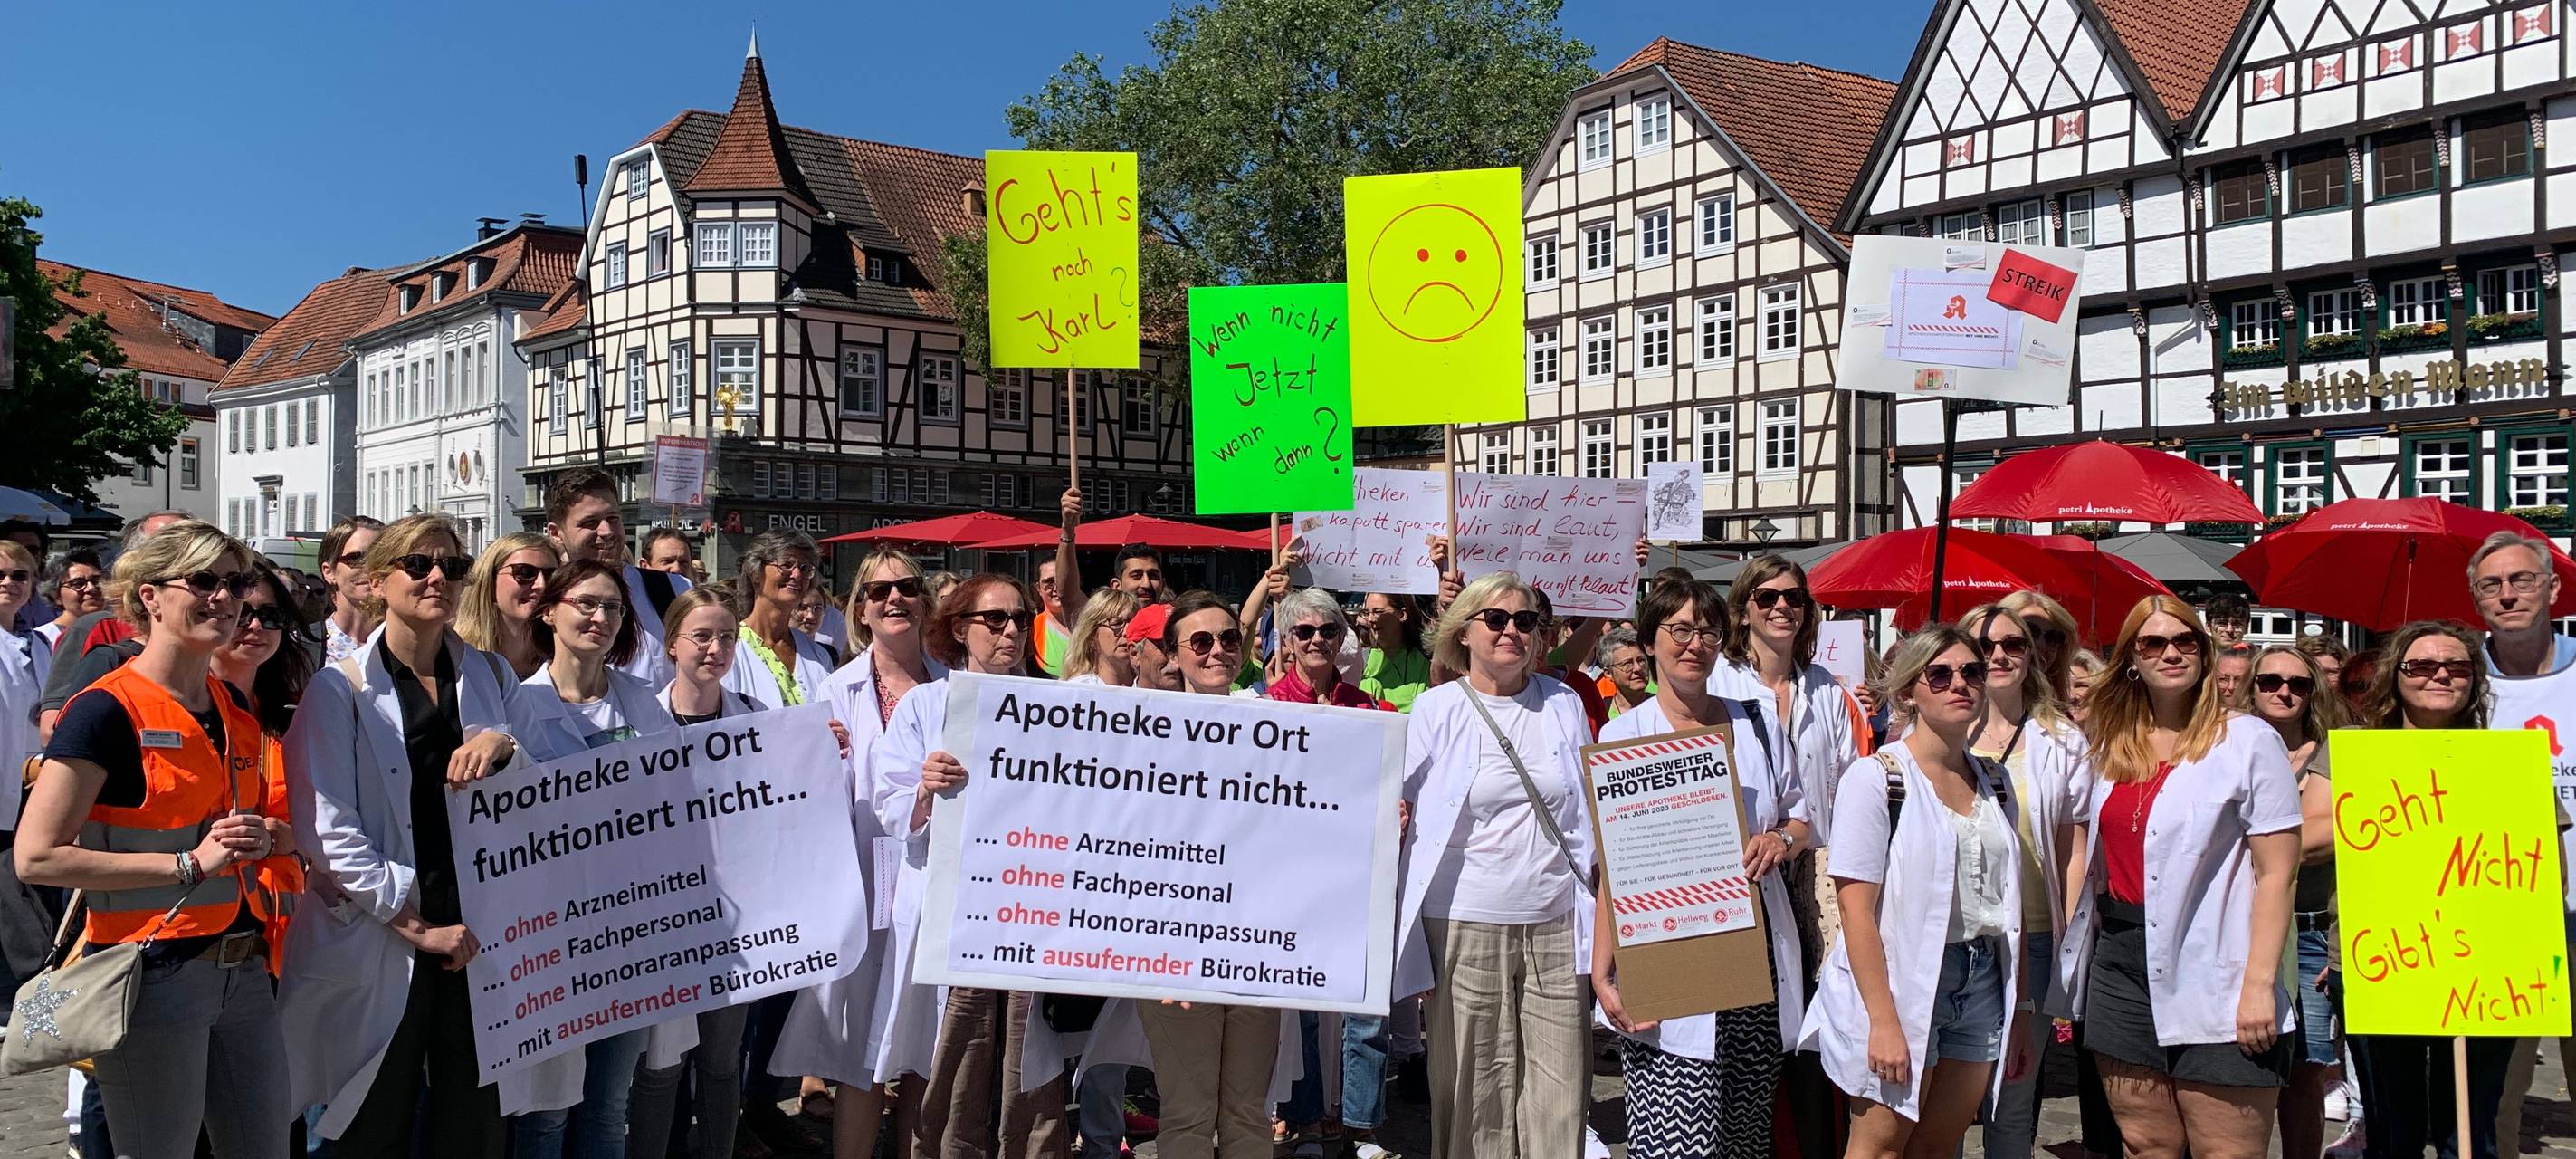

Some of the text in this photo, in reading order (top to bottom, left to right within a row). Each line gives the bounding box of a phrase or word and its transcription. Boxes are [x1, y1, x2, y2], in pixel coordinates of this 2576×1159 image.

[995, 161, 1131, 244] Geht's
[1052, 247, 1092, 281] noch
[2002, 268, 2065, 302] STREIK
[1193, 303, 1338, 358] Wenn nicht
[1226, 354, 1318, 407] Jetzt
[2219, 357, 2548, 410] Im wilden Mann
[661, 437, 705, 447] INFORMATION
[1212, 425, 1264, 463] wann
[1457, 477, 1493, 508] Wir
[1503, 486, 1549, 512] sind
[1561, 479, 1608, 508] hier
[2058, 505, 2083, 516] petri
[768, 514, 827, 532] ENGEL
[1329, 512, 1388, 532] kaputt
[1455, 512, 1492, 536] Wir
[1498, 514, 1541, 538] sind
[1302, 541, 1358, 567] Nicht
[1369, 547, 1403, 566] mit
[1519, 549, 1572, 566] man
[1584, 549, 1622, 566] uns
[1531, 574, 1577, 598] kunft
[1943, 579, 1967, 589] petri
[995, 693, 1311, 753] Apotheke vor Ort
[467, 726, 763, 825] Apotheke vor Ort
[989, 747, 1340, 812] funktioniert nicht...
[1597, 761, 1728, 801] PROTESTTAG
[1607, 752, 1713, 783] BUNDESWEITER
[1616, 787, 1716, 814] UNSERE APOTHEKE BLEIBT
[1619, 812, 1630, 820] 14.
[1632, 809, 1650, 819] JUNI
[1652, 805, 1669, 814] 2023
[1671, 792, 1728, 809] GESCHLOSSEN.
[2335, 768, 2448, 851] Geht
[472, 780, 807, 883] funktioniert nicht...
[1006, 827, 1069, 852] ohne
[1075, 832, 1226, 866] Arzneimittel
[2437, 832, 2543, 896] Nicht
[504, 907, 558, 943] ohne
[564, 864, 708, 922] Arzneimittel
[1001, 865, 1064, 890] ohne
[1073, 870, 1232, 904] Fachpersonal
[997, 903, 1061, 928] ohne
[1068, 908, 1298, 951] Honoraranpassung
[1635, 906, 1748, 931] Markt Hellweg Ruhr
[510, 946, 562, 982] ohne
[568, 898, 724, 960] Fachpersonal
[2352, 909, 2472, 982] Gibt's
[514, 983, 565, 1021] ohne
[571, 923, 799, 996] Honoraranpassung
[993, 942, 1035, 965] mit
[1042, 947, 1193, 978] ausufernder
[1201, 957, 1327, 989] Bürokratie
[517, 1028, 553, 1058] mit
[557, 982, 702, 1040] ausufernder
[710, 949, 839, 996] Bürokratie
